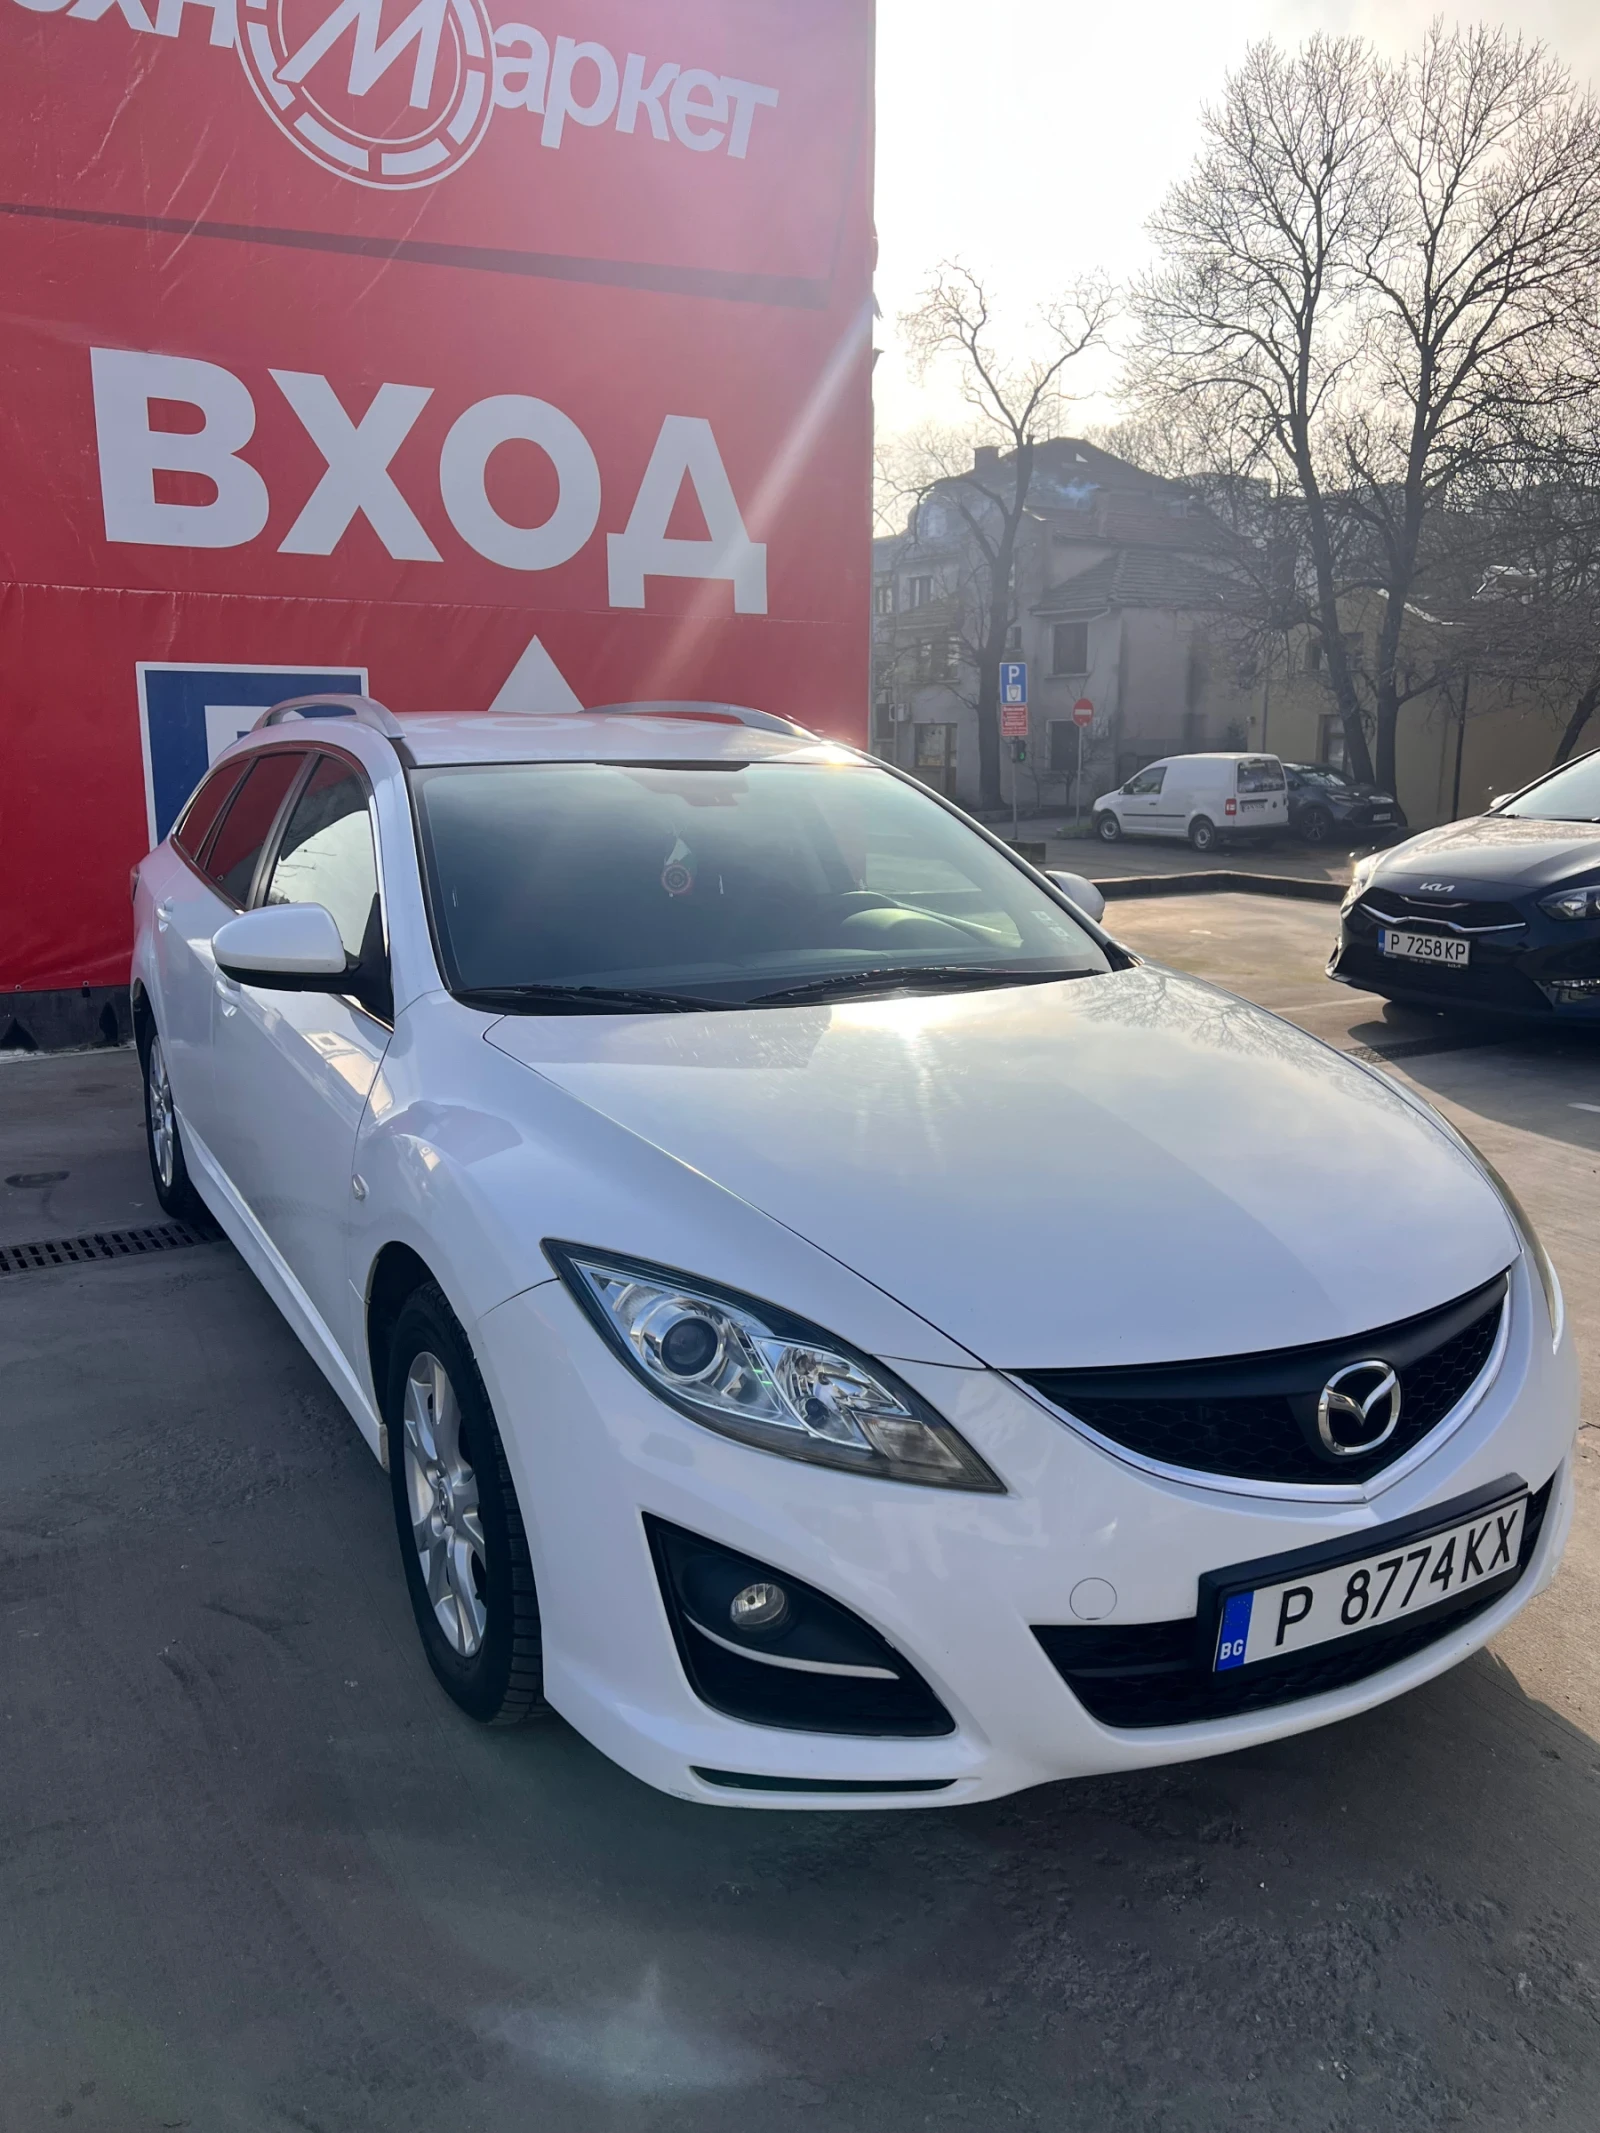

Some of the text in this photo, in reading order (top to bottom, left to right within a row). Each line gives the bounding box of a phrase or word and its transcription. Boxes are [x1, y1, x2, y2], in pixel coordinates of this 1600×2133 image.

[89, 346, 768, 615] ВХОД
[1008, 665, 1020, 683] P
[1390, 933, 1466, 961] P 7258KP
[1274, 1508, 1520, 1647] P 8774KX
[1219, 1638, 1244, 1660] BG
